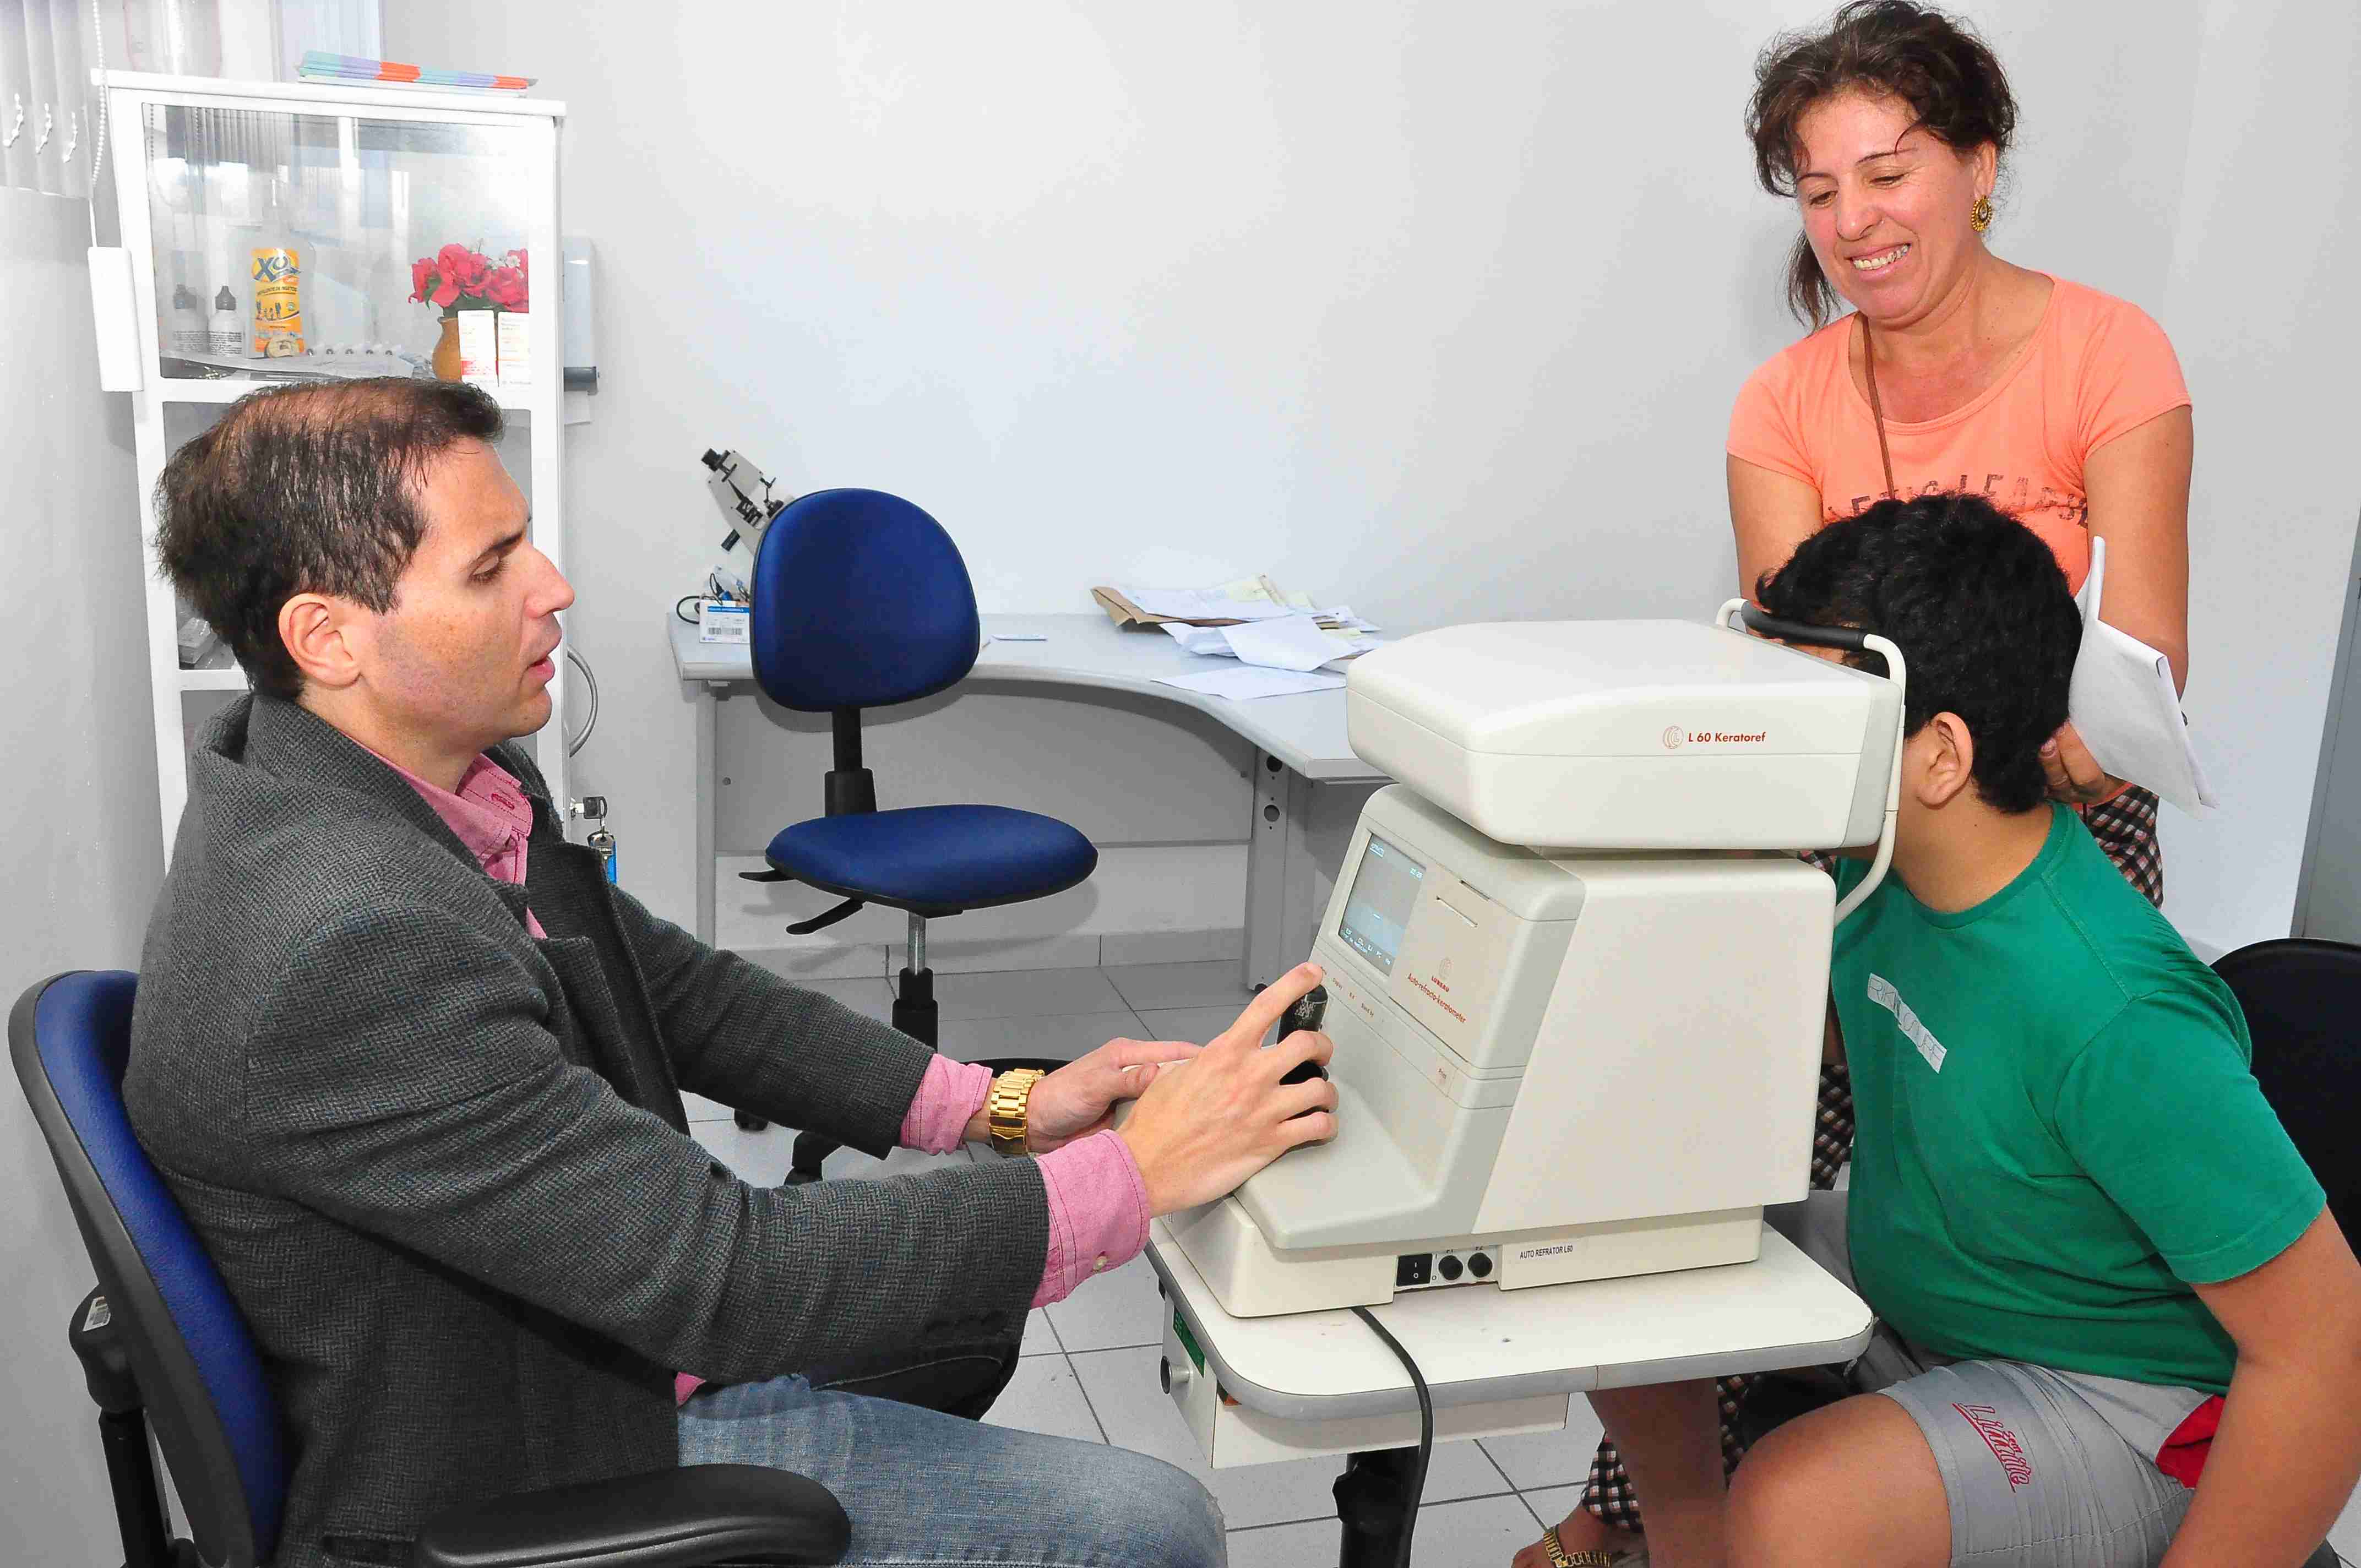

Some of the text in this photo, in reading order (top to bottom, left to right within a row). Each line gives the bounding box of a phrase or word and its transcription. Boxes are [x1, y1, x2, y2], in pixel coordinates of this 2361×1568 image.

[1688, 731, 1766, 742] L 60 Keratoref
[1407, 972, 1466, 1023] Auto-refracto-keratometer
[1520, 1245, 1573, 1259] AUTO REFRATOR L60
